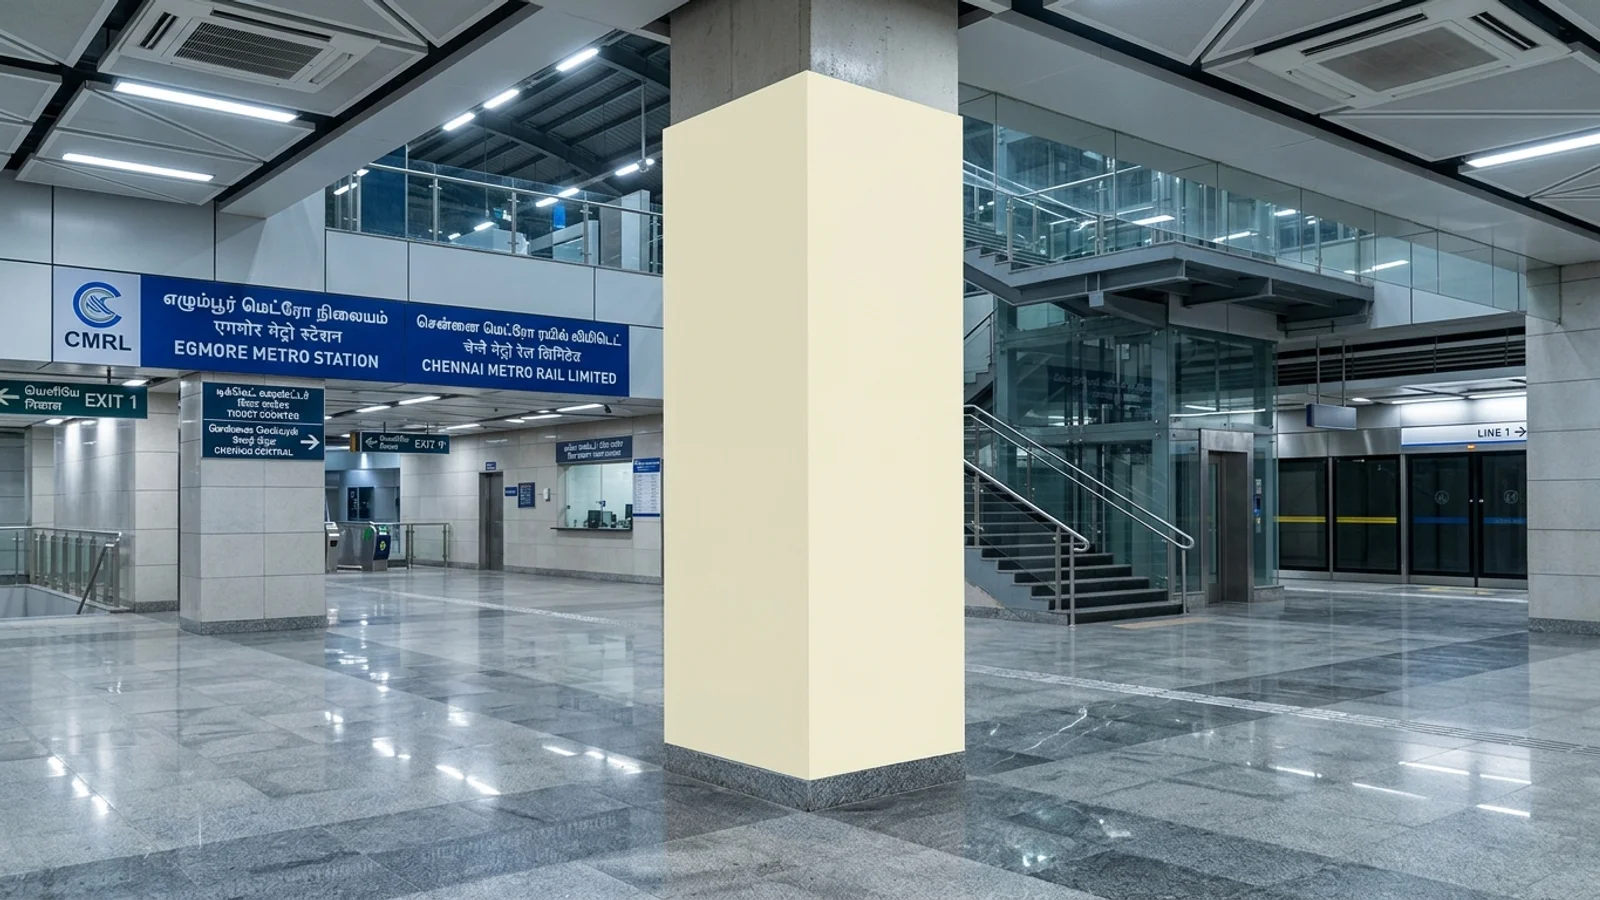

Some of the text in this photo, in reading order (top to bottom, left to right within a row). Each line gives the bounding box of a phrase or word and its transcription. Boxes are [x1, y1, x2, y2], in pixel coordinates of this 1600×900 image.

[64, 330, 132, 351] CMRL
[174, 340, 379, 368] EGMORE METRO STATION
[422, 359, 617, 385] CHENNAI METRO RAIL LIMITED
[85, 393, 137, 409] EXIT 1
[1477, 428, 1510, 438] LINE 1
